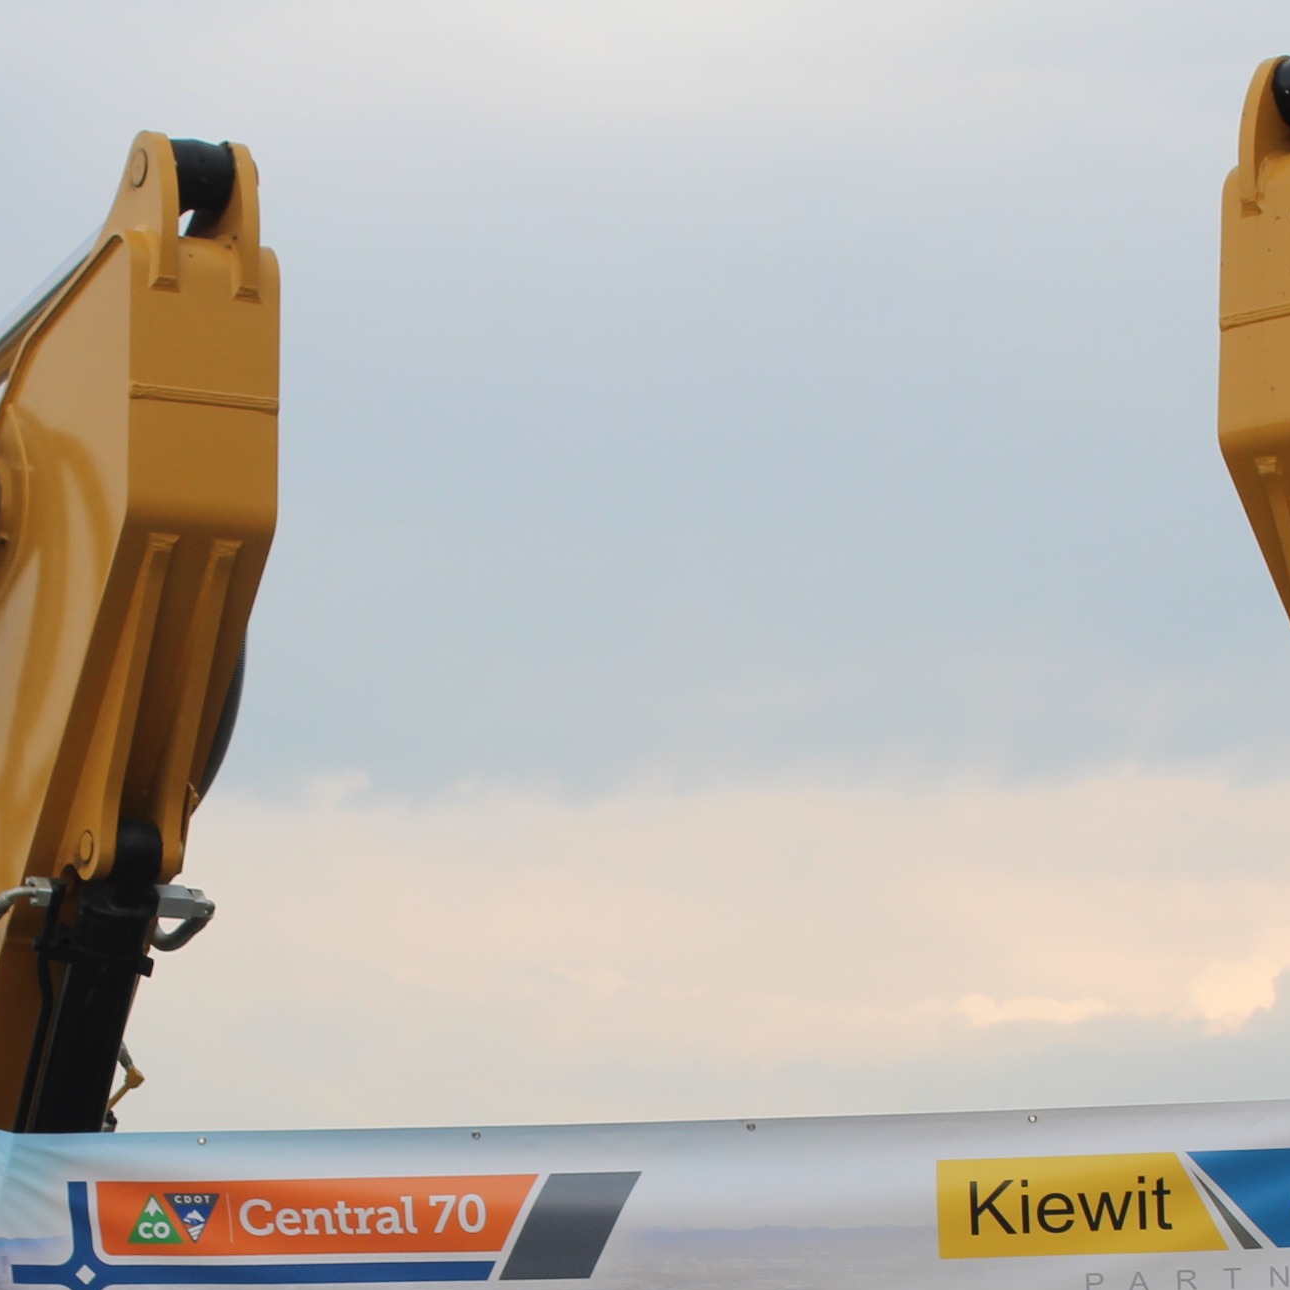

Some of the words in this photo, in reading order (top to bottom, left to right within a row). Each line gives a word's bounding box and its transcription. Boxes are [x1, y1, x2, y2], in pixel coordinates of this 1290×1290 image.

[173, 1194, 211, 1204] CDOT
[970, 1176, 1173, 1235] Kiewit
[138, 1221, 170, 1239] CO
[239, 1196, 417, 1236] Central
[429, 1194, 486, 1233] 70
